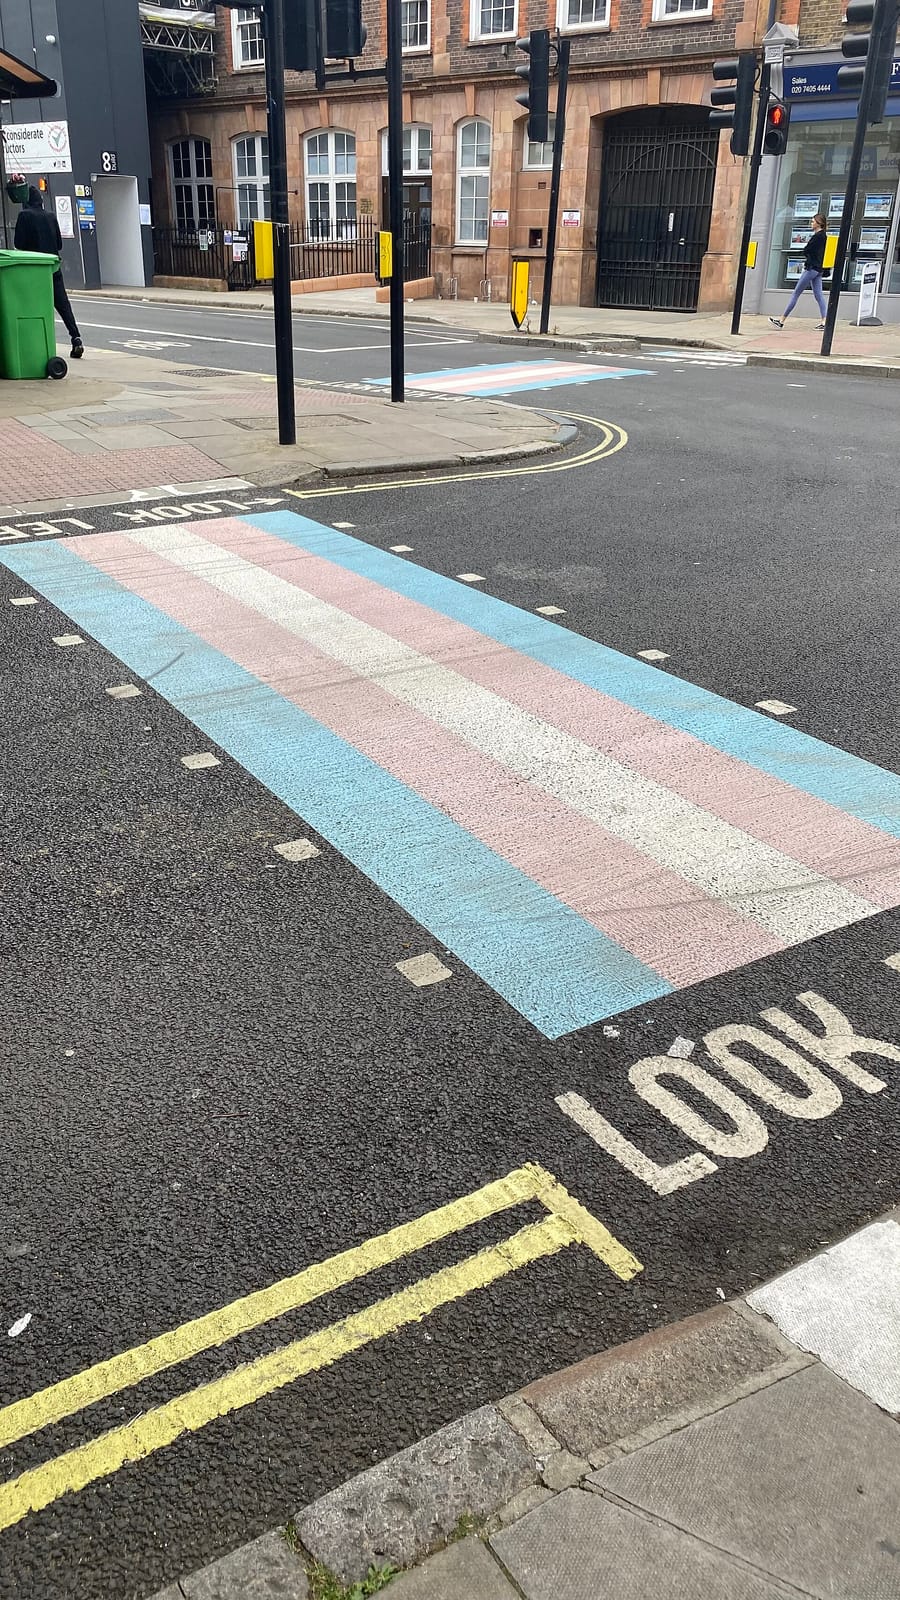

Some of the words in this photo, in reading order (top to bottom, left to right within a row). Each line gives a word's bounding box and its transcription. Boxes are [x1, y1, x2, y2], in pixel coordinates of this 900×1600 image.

[791, 77, 807, 85] Sales
[791, 86, 801, 94] 020
[6, 127, 44, 141] considerate
[102, 151, 111, 172] 8
[112, 500, 252, 523] LOOK
[554, 990, 900, 1195] LOOK
